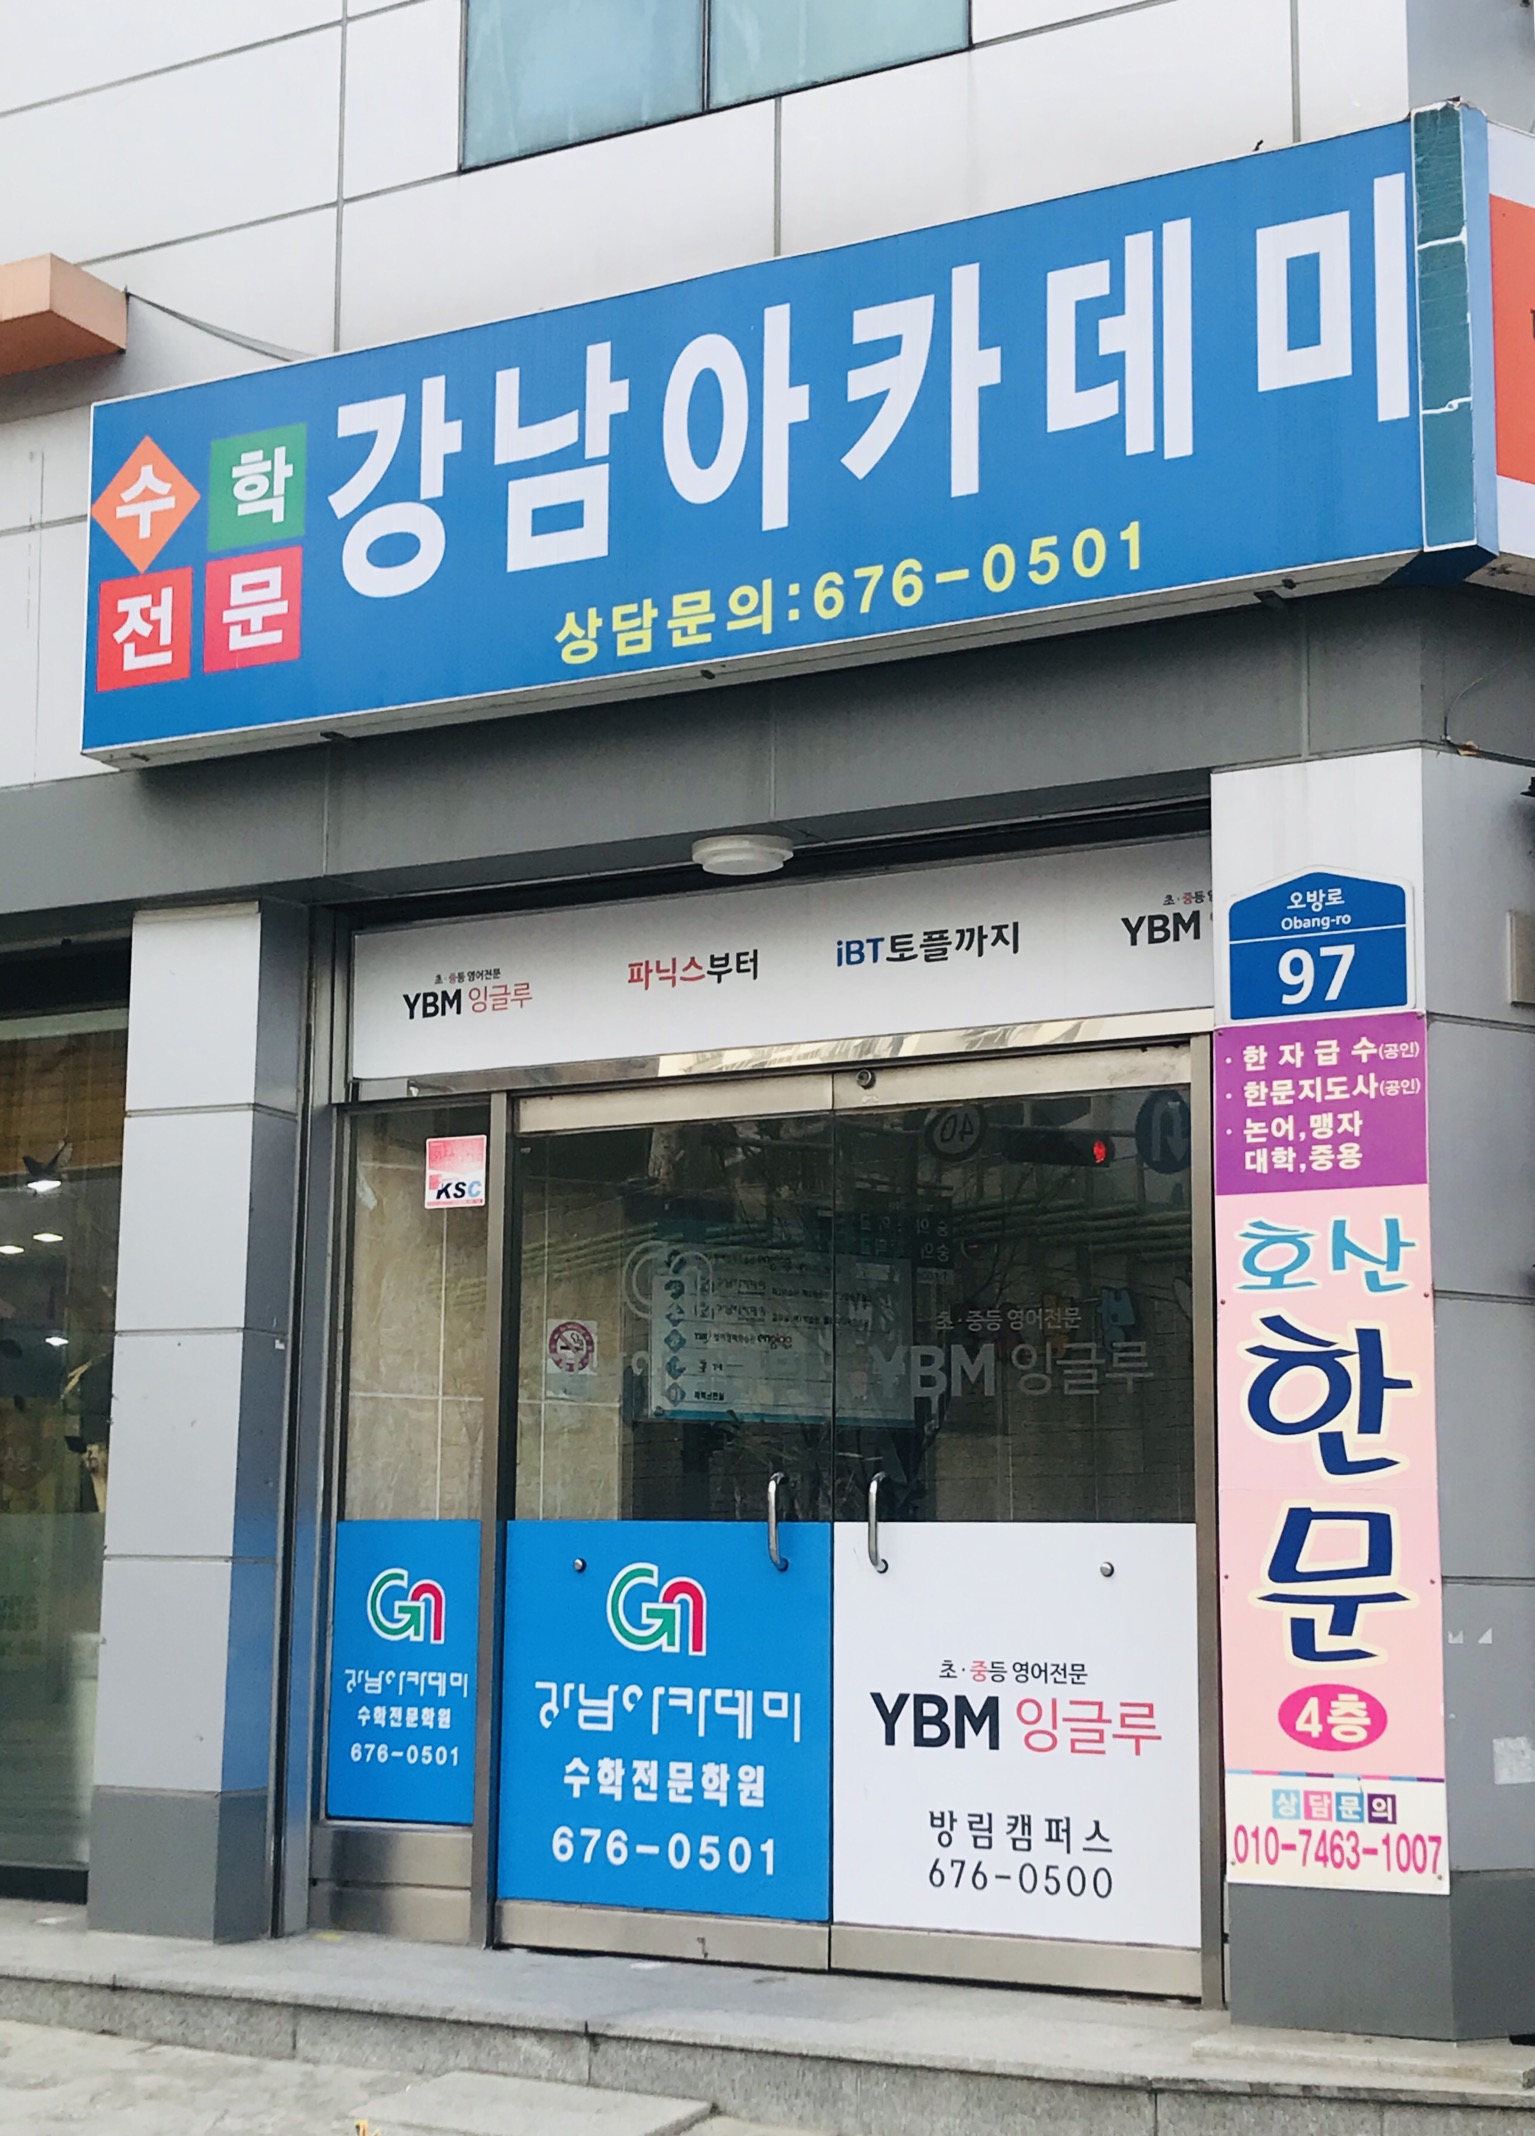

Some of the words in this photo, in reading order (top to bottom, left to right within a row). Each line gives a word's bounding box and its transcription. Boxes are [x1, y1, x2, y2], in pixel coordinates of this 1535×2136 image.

[328, 171, 1411, 598] 강남아카데미
[1286, 887, 1346, 913] 오방로
[1121, 909, 1201, 947] YBM
[1280, 913, 1352, 931] Obang-ro
[836, 921, 1020, 967] iBT토플까지
[466, 967, 502, 982] 영어전문
[627, 948, 760, 991] 파닉스부터
[1278, 943, 1356, 1006] 97
[402, 988, 462, 1020] YBM
[468, 981, 533, 1014] 잉글루
[436, 1180, 483, 1200] KSC
[1236, 1217, 1417, 1293] 호산
[1007, 1306, 1082, 1330] 영어전문
[868, 1343, 996, 1398] YBM
[1011, 1341, 1155, 1396] 잉글루
[1244, 1314, 1414, 1662] 한문
[344, 1669, 469, 1698] 강남아카데미
[1012, 1661, 1089, 1685] 영어전문
[357, 1705, 452, 1729] 수학전문학원
[535, 1680, 801, 1743] 강남아카데미
[869, 1692, 1000, 1751] YBM
[1015, 1697, 1163, 1756] 잉글루
[1294, 1693, 1372, 1744] 4층
[350, 1742, 459, 1767] 676-0501
[563, 1756, 765, 1808] 수학전문학원
[1275, 1790, 1395, 1823] 상담문의
[551, 1825, 776, 1876] 676-0501
[1233, 1824, 1443, 1875] 010-7463-1007
[928, 1857, 1113, 1899] 676-0500
